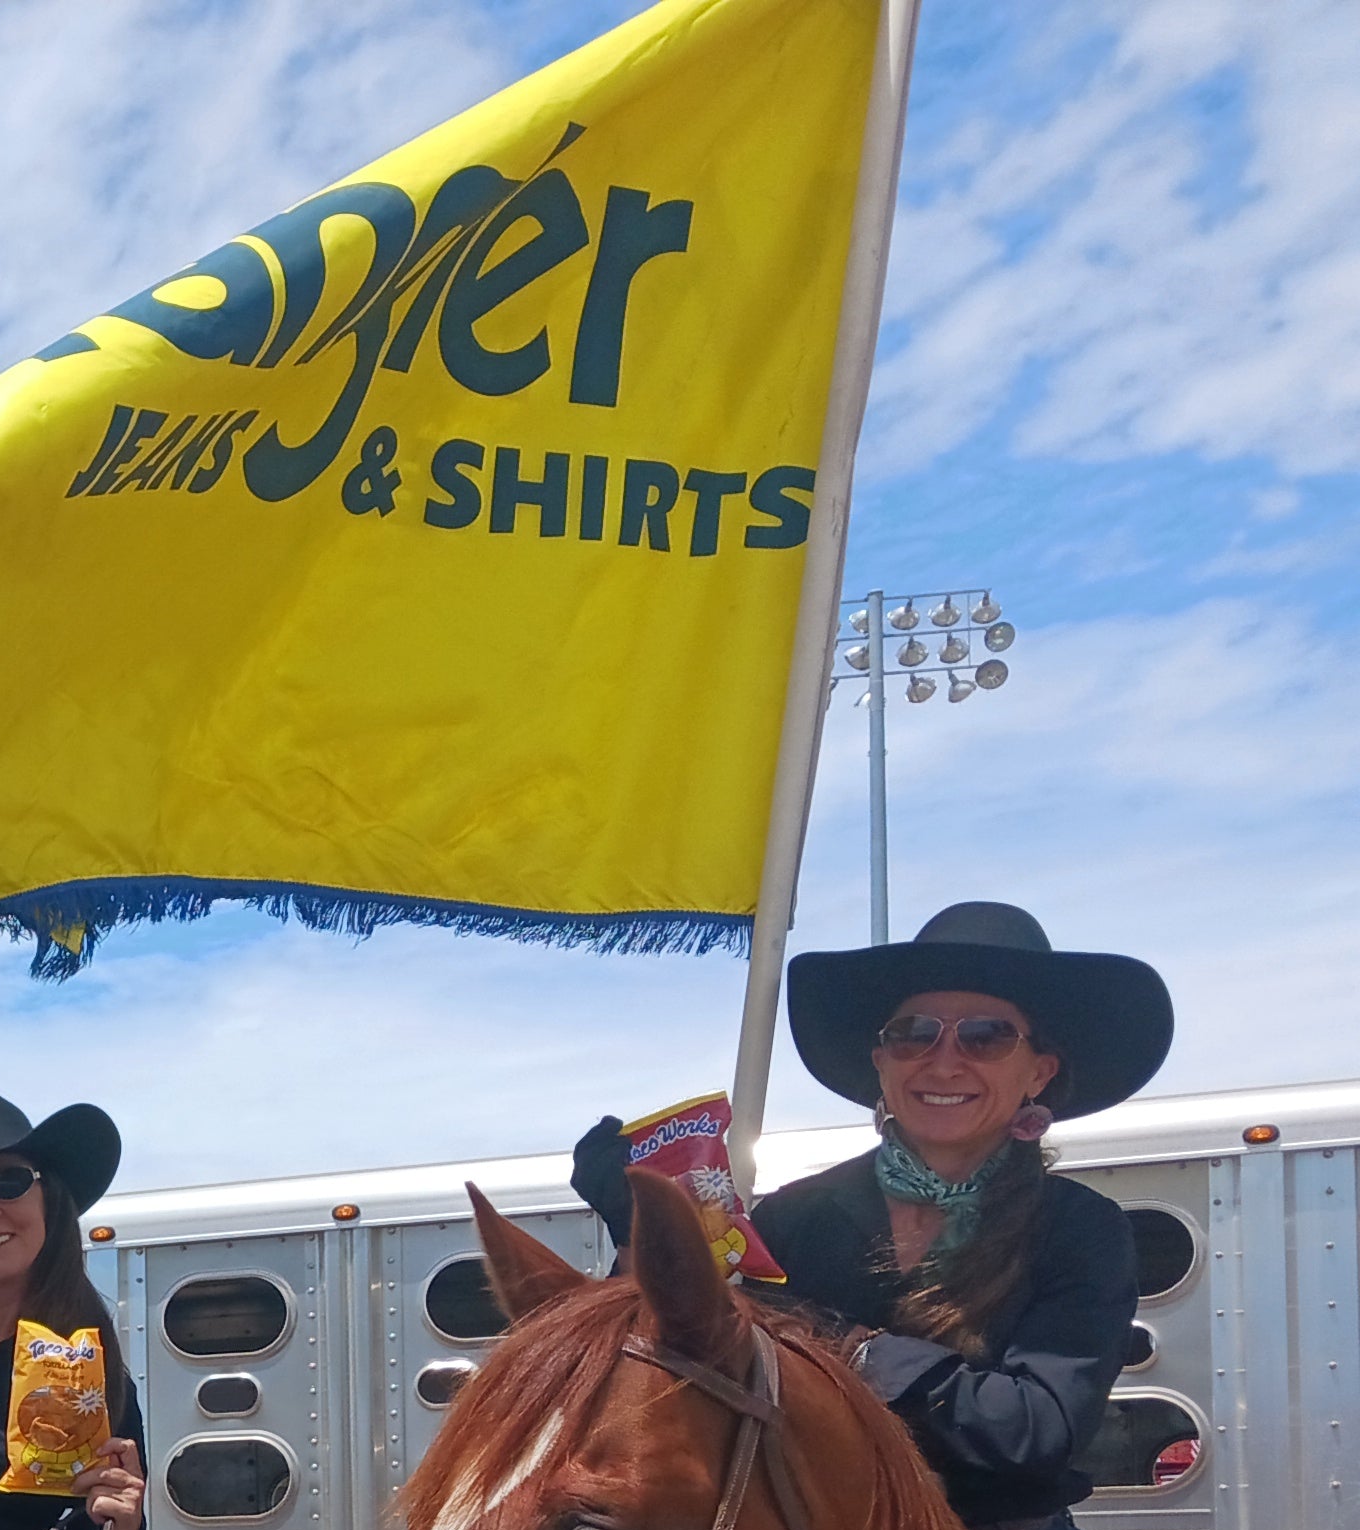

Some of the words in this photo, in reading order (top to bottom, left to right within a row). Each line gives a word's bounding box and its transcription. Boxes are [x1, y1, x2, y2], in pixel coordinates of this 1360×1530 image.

[32, 120, 694, 503] angler
[64, 403, 261, 499] JEANS
[340, 424, 403, 519] &
[422, 436, 818, 558] SHIRTS
[629, 1135, 659, 1164] aco
[656, 1112, 719, 1145] Works
[28, 1339, 63, 1360] Taco
